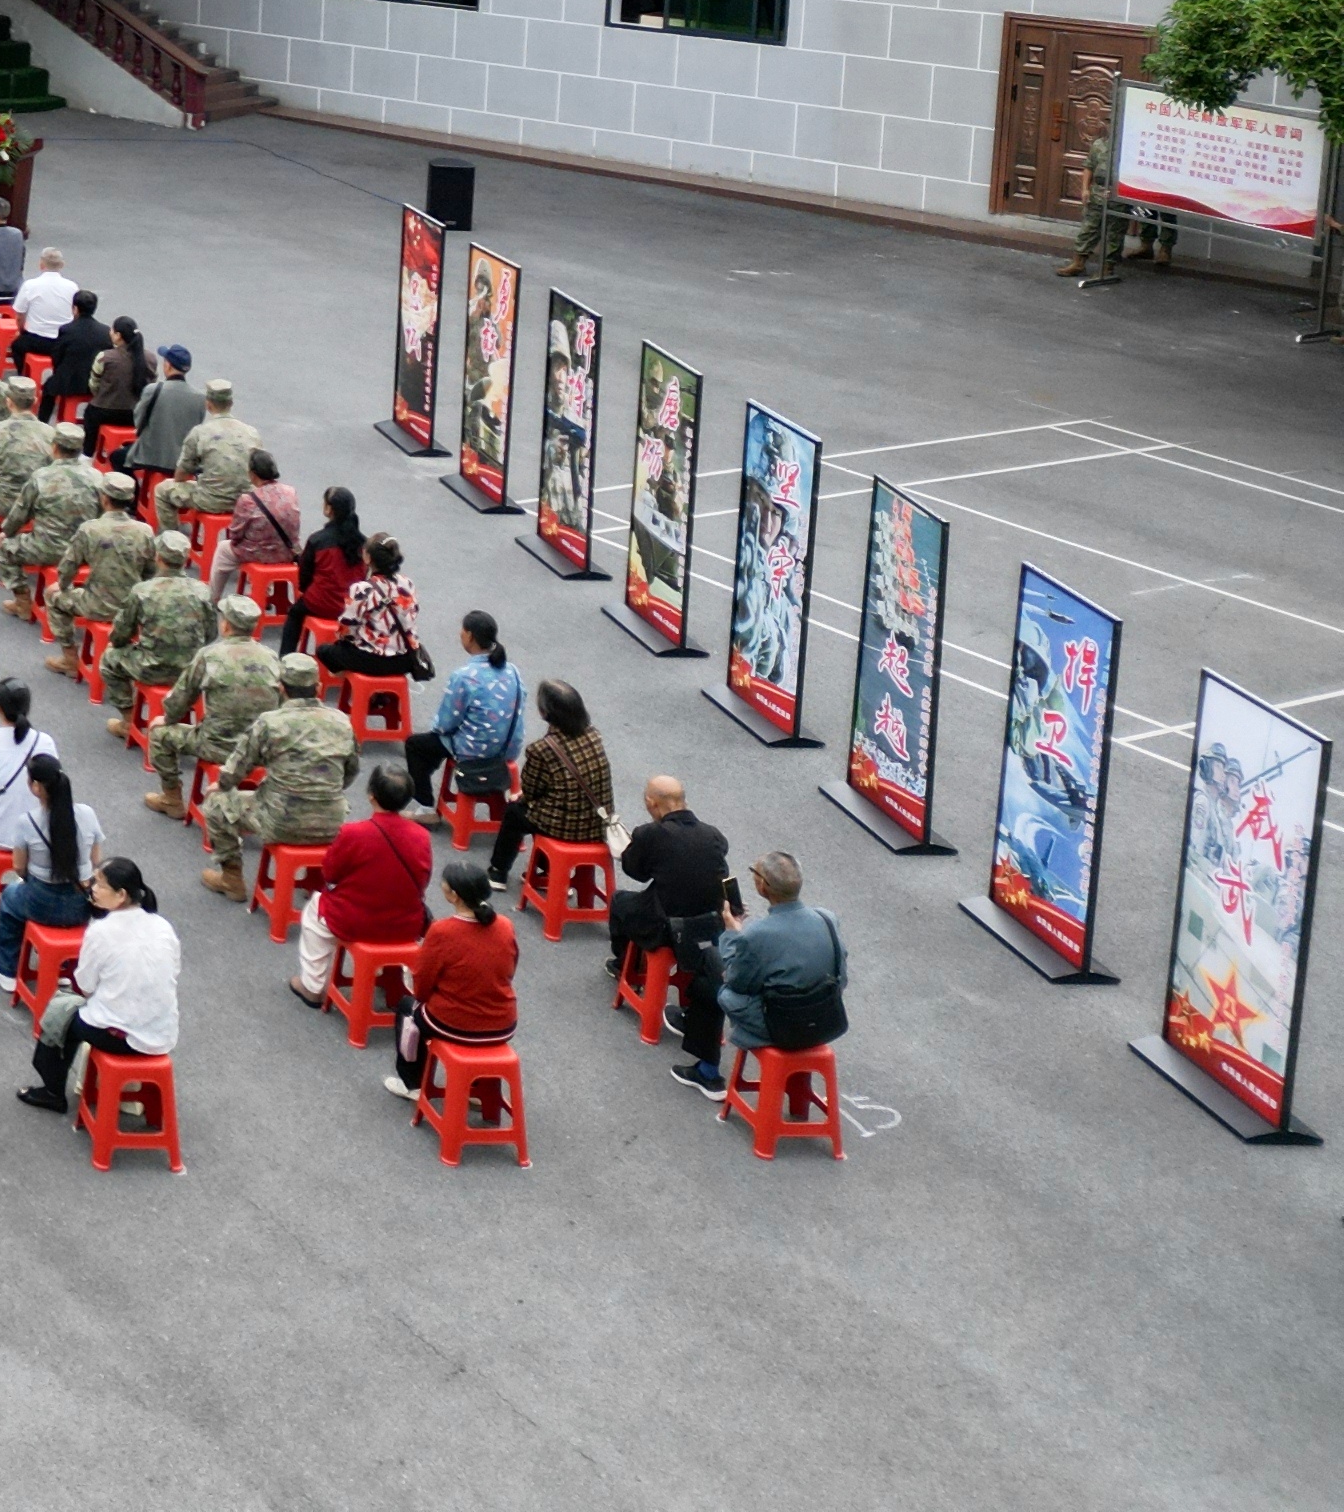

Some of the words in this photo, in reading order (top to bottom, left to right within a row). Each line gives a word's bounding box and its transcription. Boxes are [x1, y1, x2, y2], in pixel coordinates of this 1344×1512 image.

[874, 630, 914, 762] 超越
[1035, 637, 1100, 769] 捍卫
[1215, 781, 1284, 946] 威武
